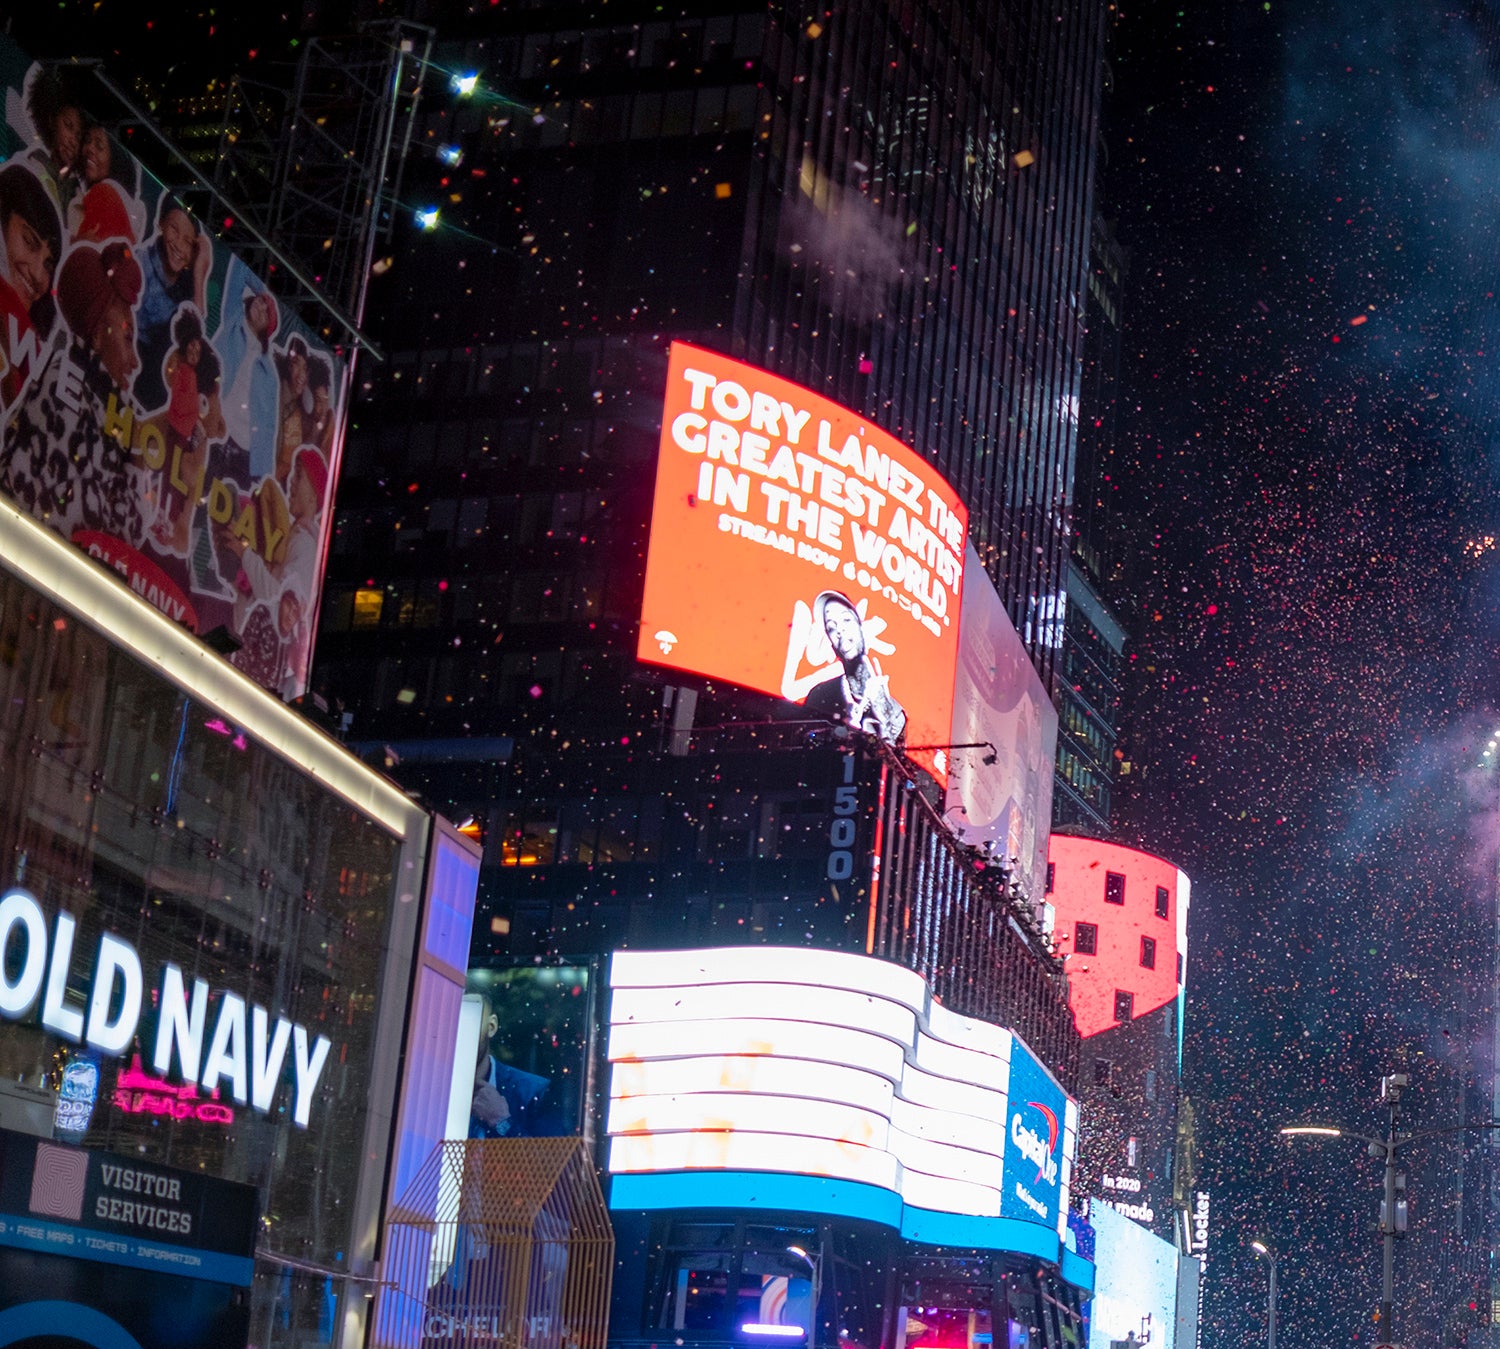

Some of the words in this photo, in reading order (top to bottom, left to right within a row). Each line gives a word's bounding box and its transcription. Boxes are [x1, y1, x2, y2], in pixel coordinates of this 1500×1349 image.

[103, 392, 283, 562] HOLIDAY
[684, 368, 811, 444] TORY
[817, 419, 925, 515] LANEZ
[927, 488, 964, 557] THE
[671, 412, 886, 526] GREATEST
[888, 506, 963, 595] ARTIST
[697, 462, 750, 513] IN
[760, 482, 844, 550] THE
[718, 513, 795, 554] STREAM
[797, 541, 840, 572] NOW
[827, 755, 858, 880] 1500
[0, 888, 144, 1053] OLD
[153, 962, 332, 1129] NAVY
[101, 1163, 182, 1201] VISITOR
[1115, 1174, 1142, 1192] 2020
[1120, 1198, 1154, 1224] made
[17, 1225, 44, 1241] FREE
[95, 1196, 192, 1235] SERVICES
[1191, 1191, 1211, 1254] Locker
